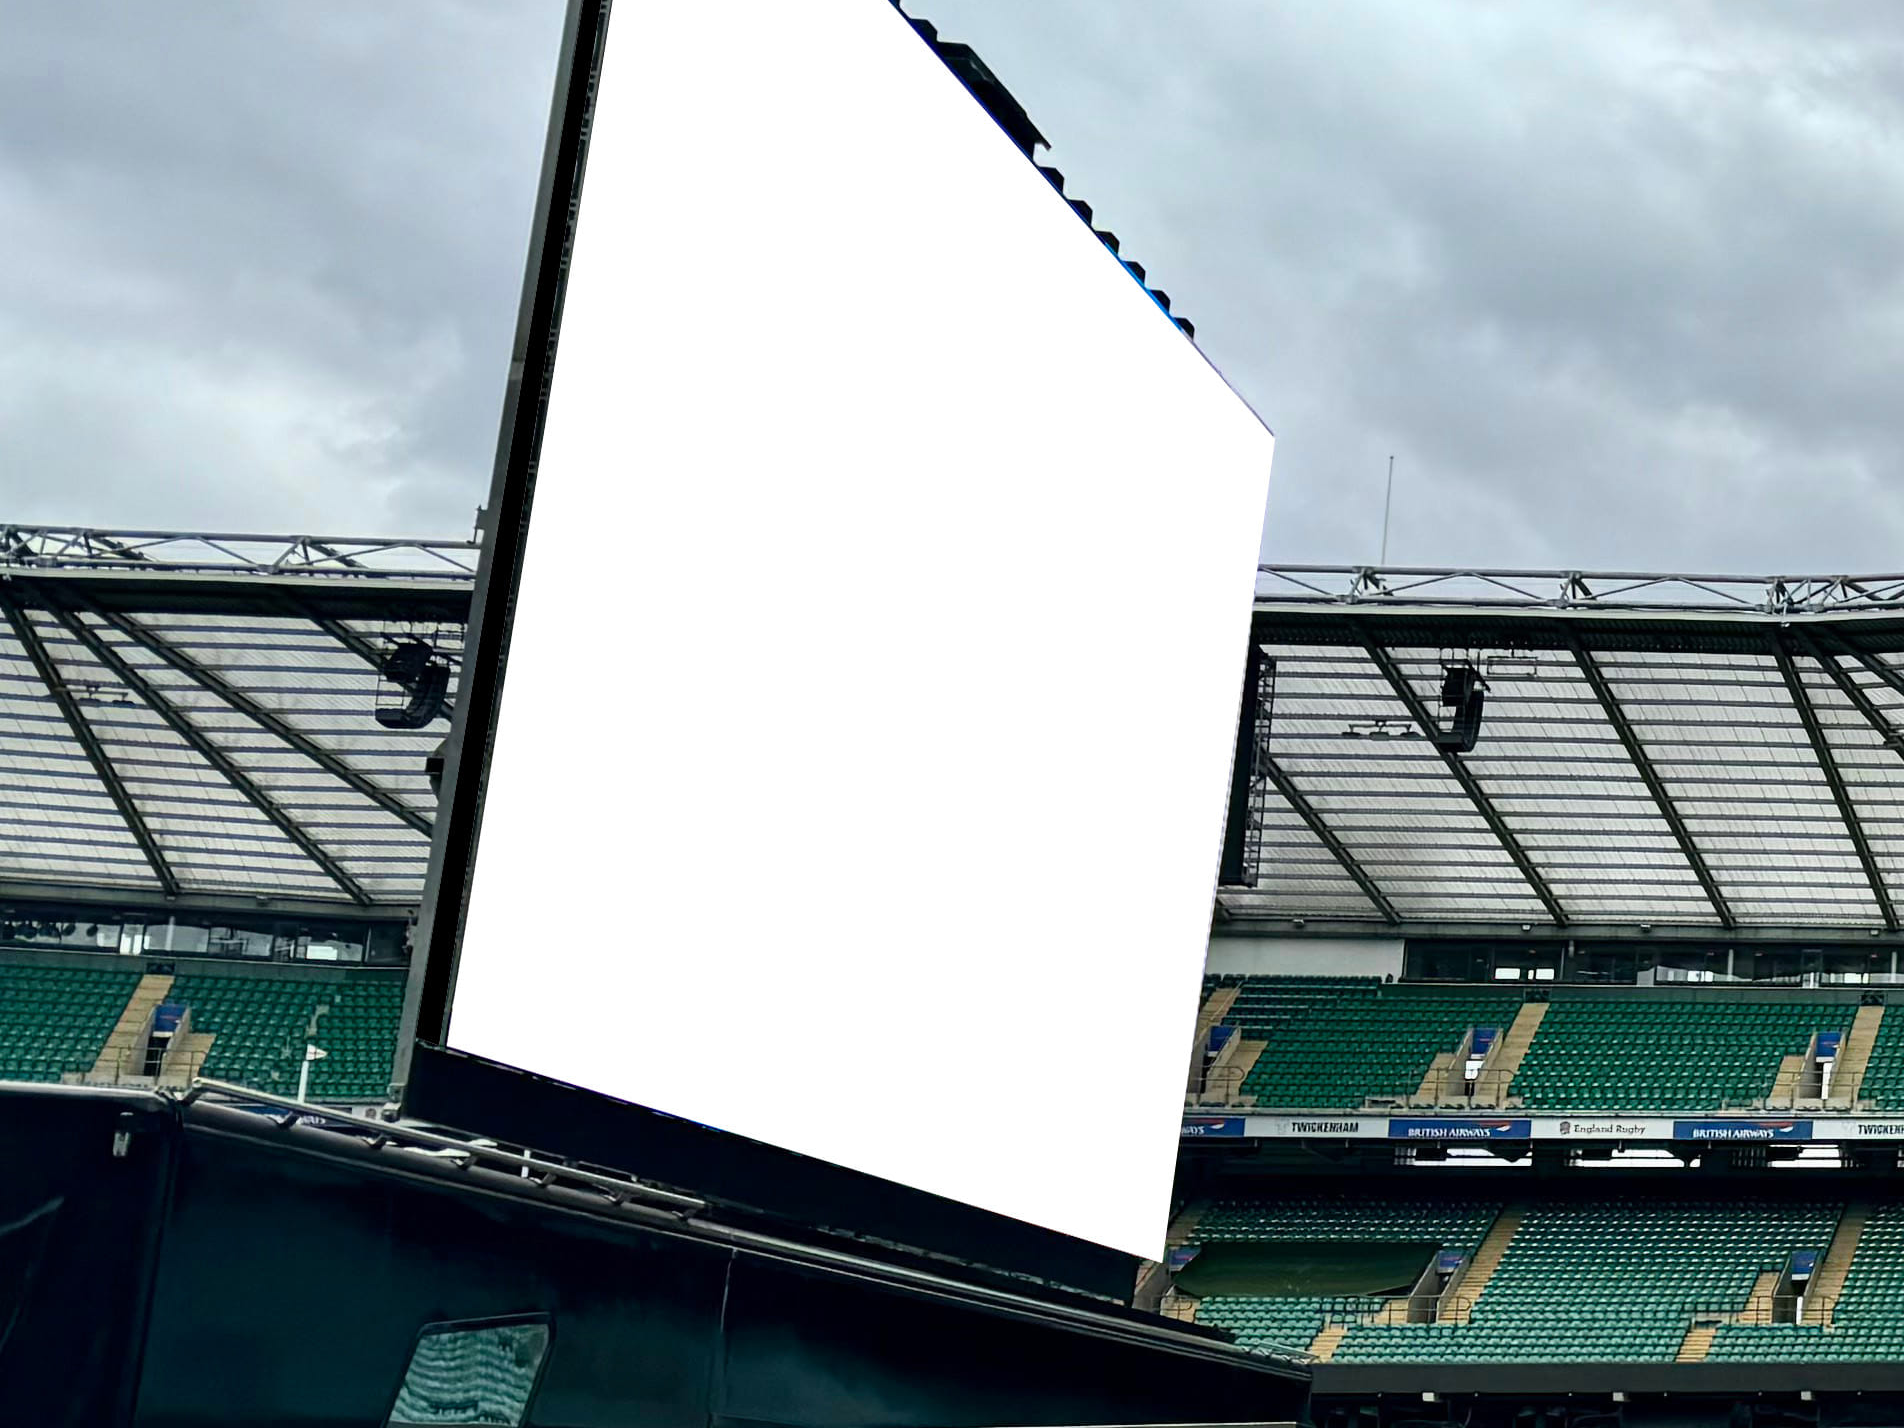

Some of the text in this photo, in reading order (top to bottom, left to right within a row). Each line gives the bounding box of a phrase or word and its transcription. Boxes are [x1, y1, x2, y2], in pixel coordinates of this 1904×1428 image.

[1291, 1121, 1359, 1134] TWICKENHAM
[1408, 1127, 1491, 1138] BRITISH AIRWAYS
[1573, 1123, 1646, 1136] England Rugby
[1692, 1127, 1774, 1138] BRITISH AIRWAYS
